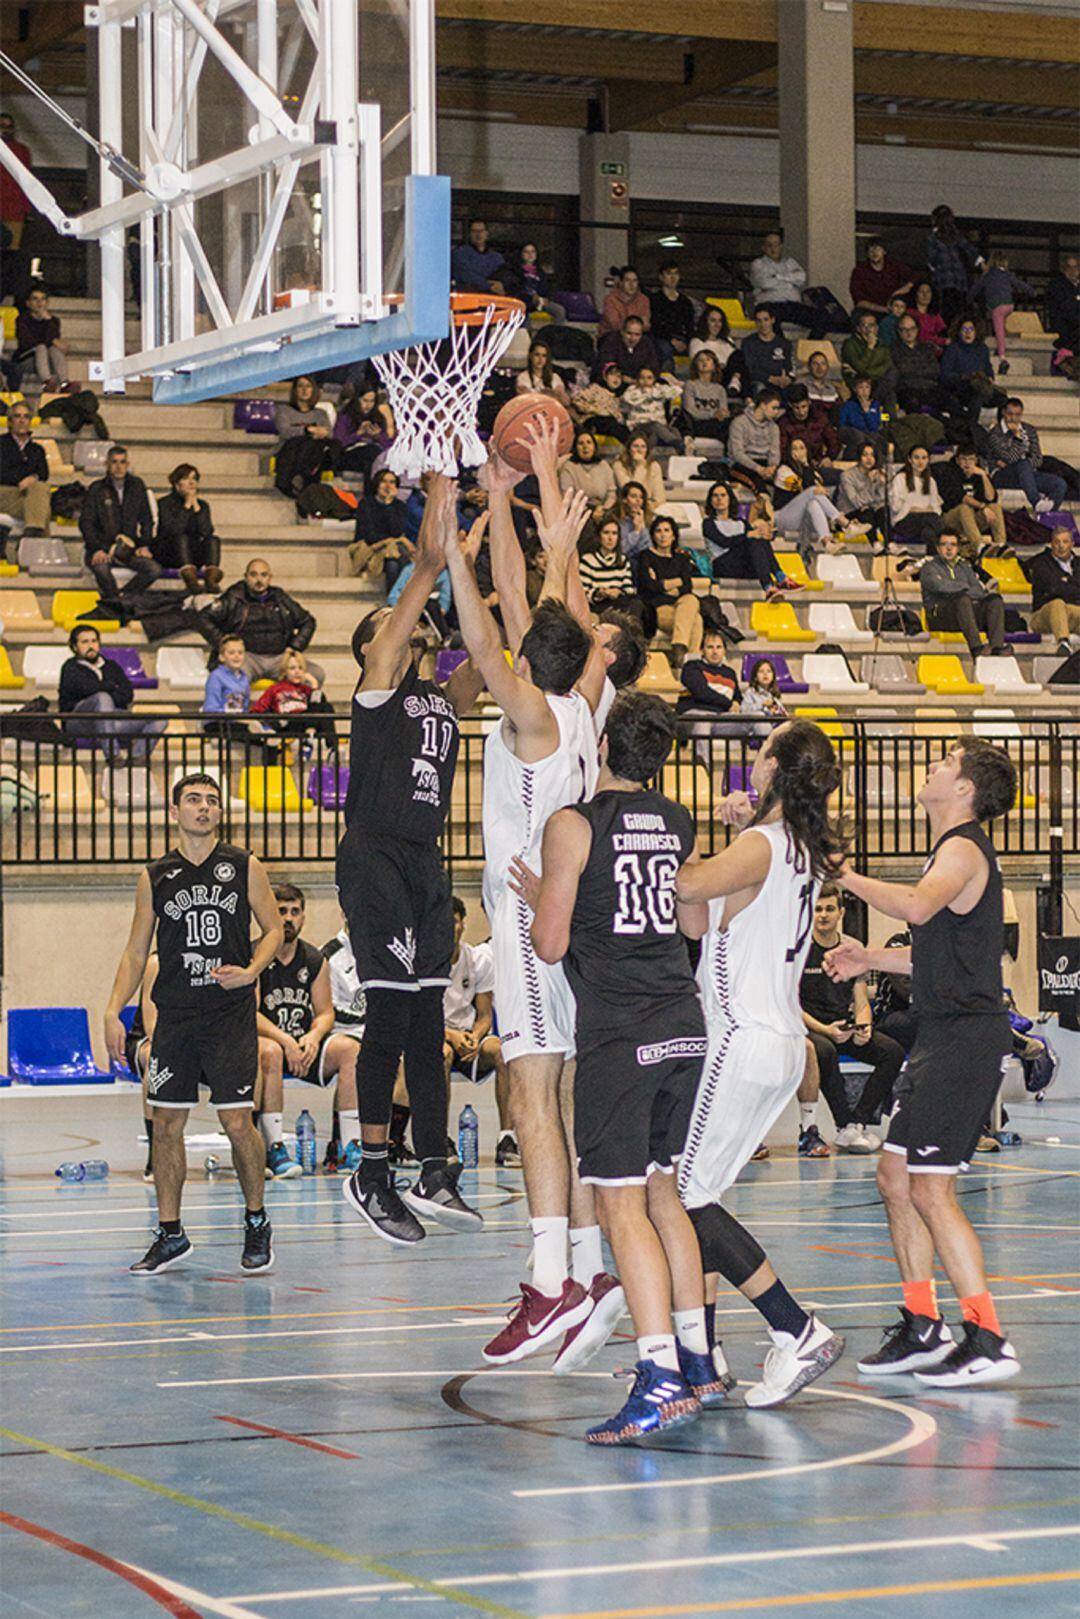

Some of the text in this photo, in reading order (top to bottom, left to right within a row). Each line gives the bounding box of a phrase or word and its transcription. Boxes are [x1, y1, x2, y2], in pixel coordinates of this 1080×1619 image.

[623, 813, 666, 831] GRUPO
[612, 833, 682, 851] CARRASCO
[163, 884, 239, 920] SORIA
[613, 854, 679, 934] 16
[185, 910, 222, 947] 18
